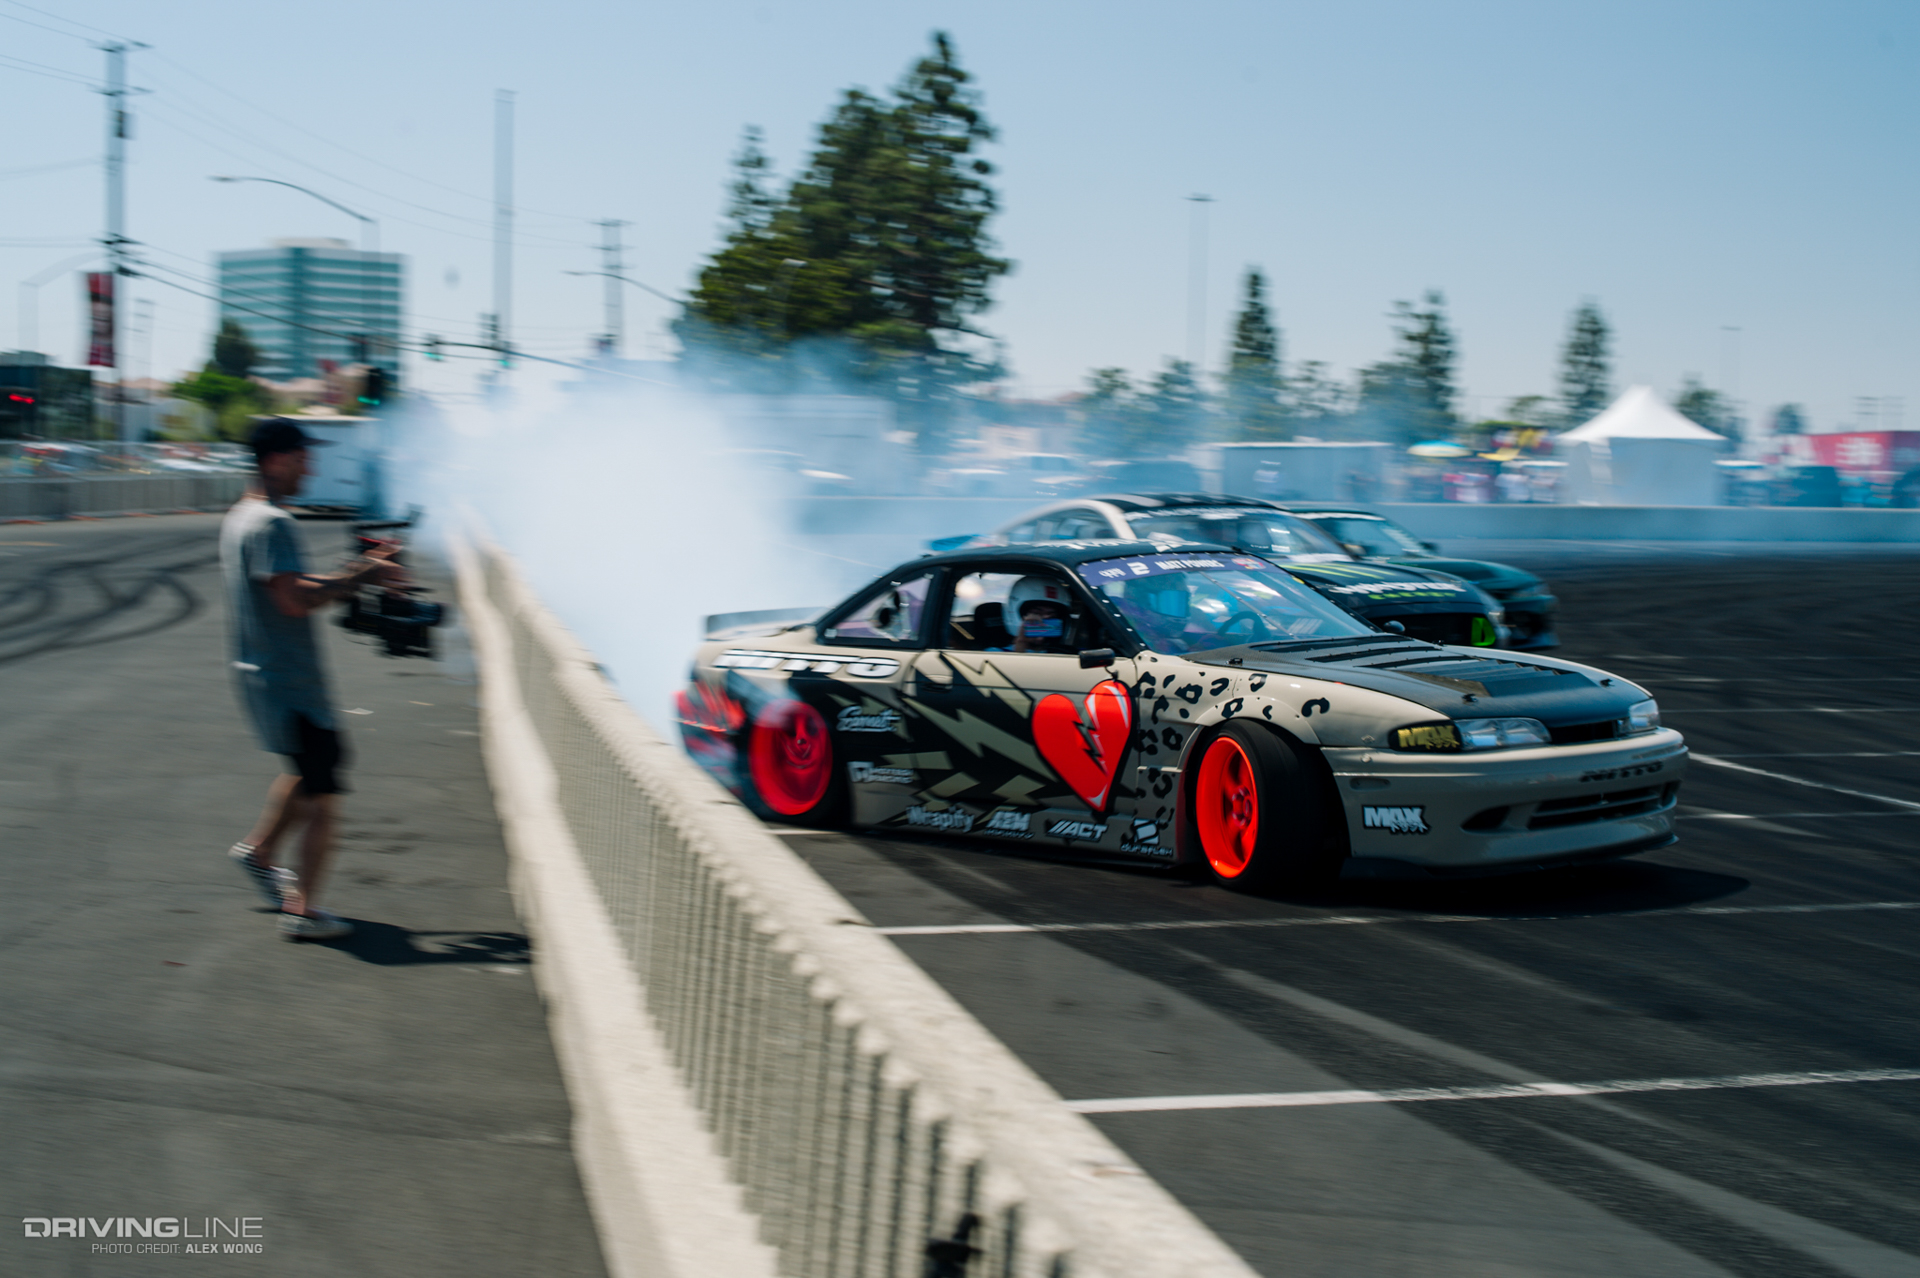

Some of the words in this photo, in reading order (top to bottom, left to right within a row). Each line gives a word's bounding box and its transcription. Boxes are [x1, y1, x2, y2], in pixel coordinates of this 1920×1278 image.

[711, 649, 900, 677] NITTO
[1397, 725, 1456, 748] MAX
[906, 805, 974, 833] Wrapify
[986, 811, 1031, 831] AEM
[1363, 806, 1423, 828] MAX
